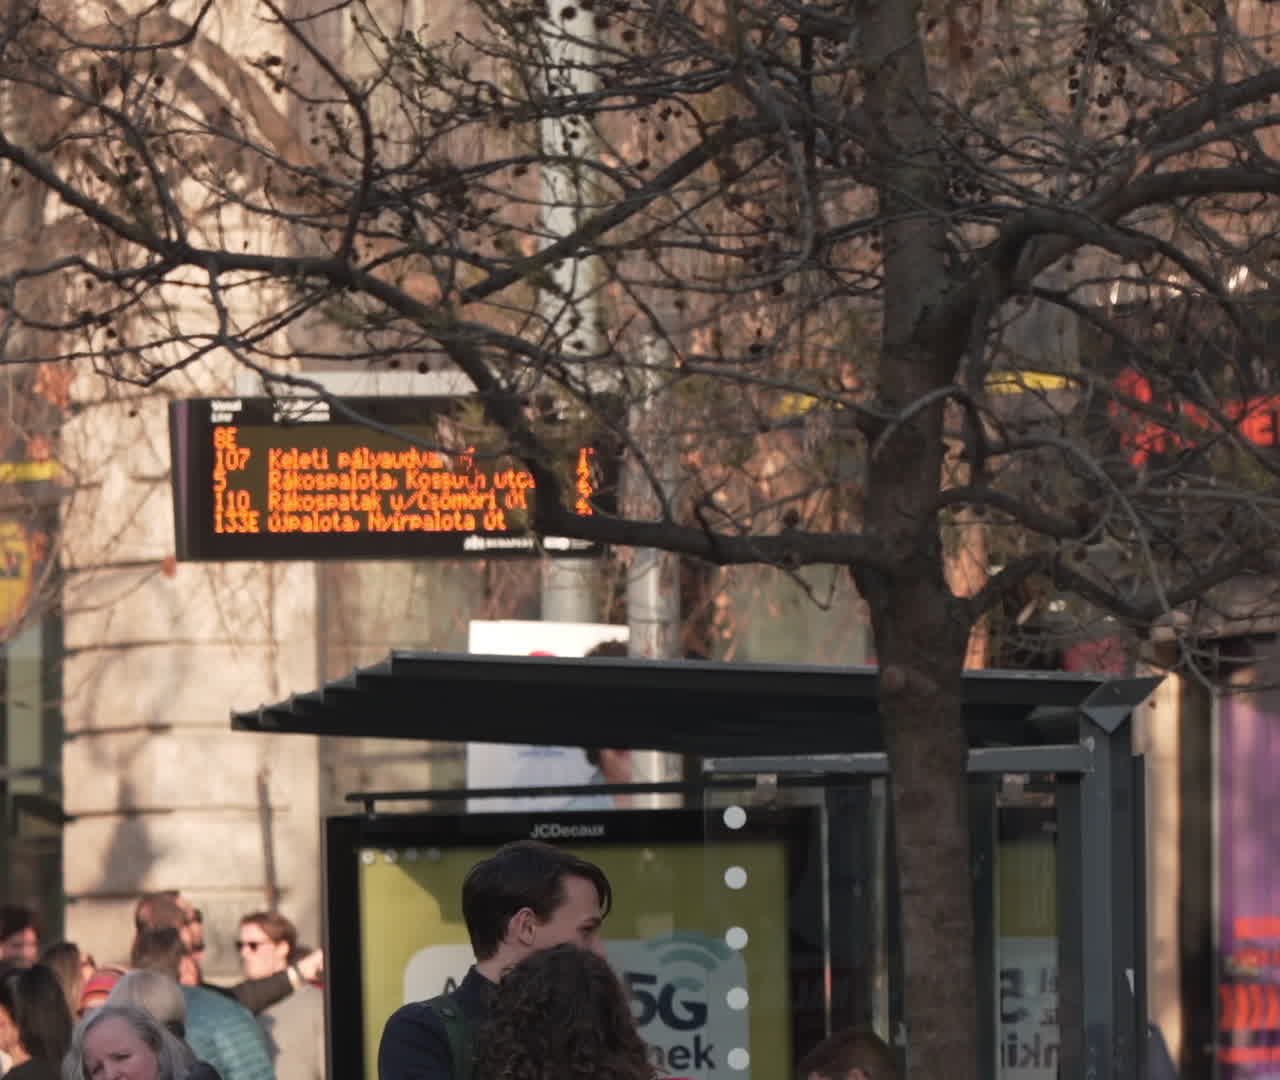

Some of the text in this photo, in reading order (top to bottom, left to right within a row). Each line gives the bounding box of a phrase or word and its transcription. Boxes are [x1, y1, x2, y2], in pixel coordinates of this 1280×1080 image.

[214, 448, 251, 471] 107
[268, 447, 330, 470] Keleti
[337, 447, 445, 470] pályaudva
[213, 470, 227, 492] 5
[215, 490, 250, 513] 110
[214, 511, 260, 533] 133E
[530, 823, 605, 838] JCDecaux
[624, 971, 708, 1031] 5G
